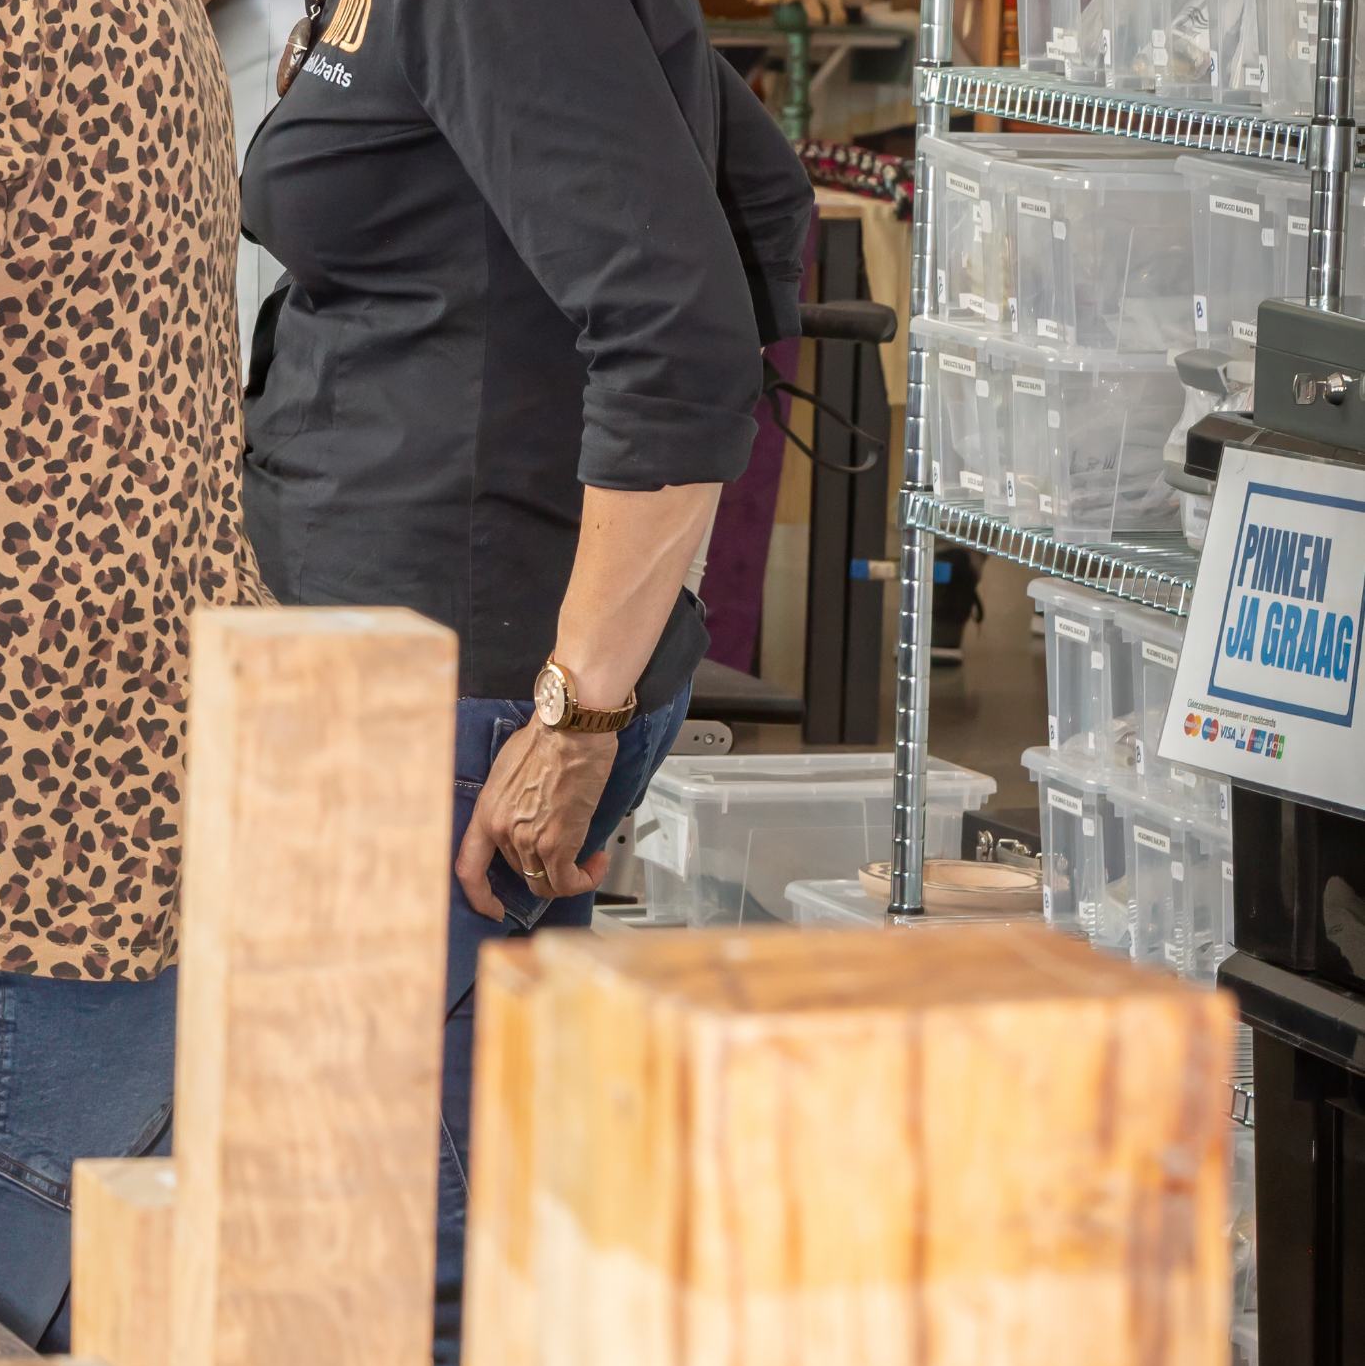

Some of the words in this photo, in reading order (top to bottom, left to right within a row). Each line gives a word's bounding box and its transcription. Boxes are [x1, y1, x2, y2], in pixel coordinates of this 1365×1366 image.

[1237, 523, 1332, 603] PINNEN
[1225, 595, 1260, 662] JA
[1260, 601, 1354, 683] GRAAG
[1221, 725, 1236, 740] VISA
